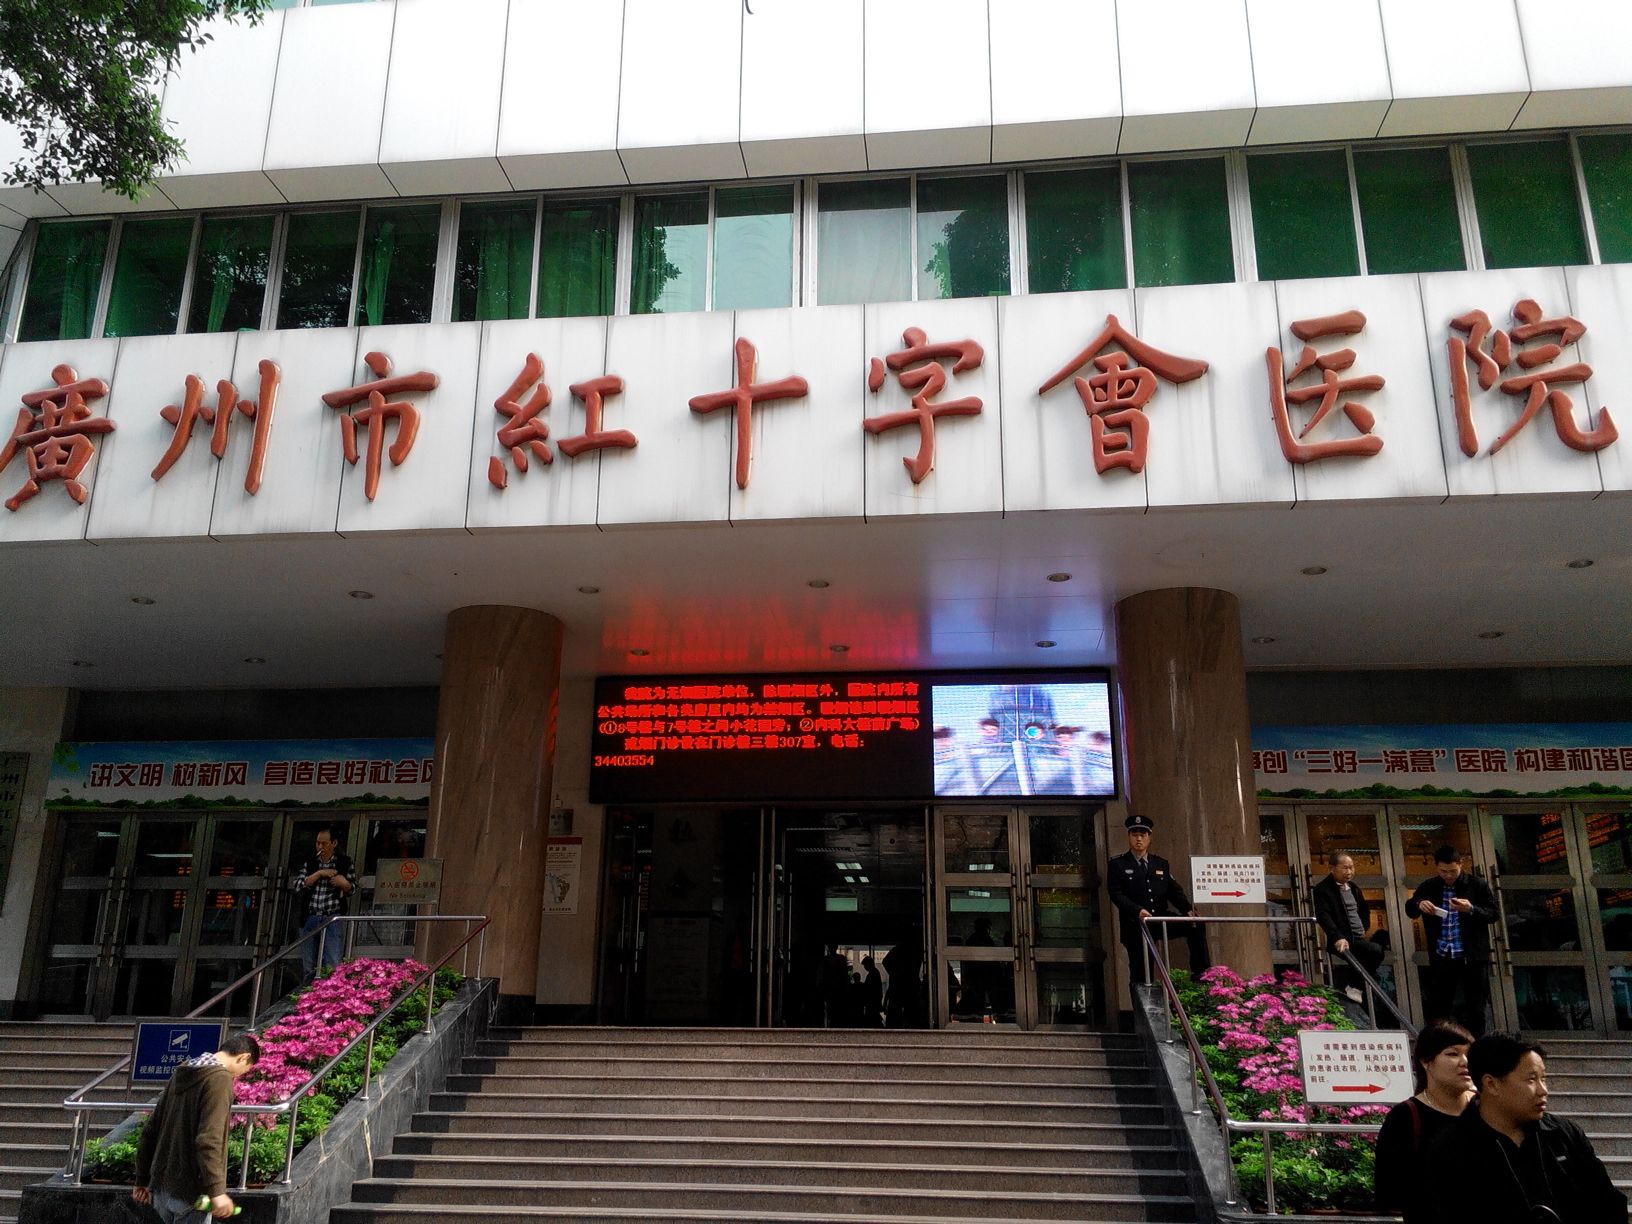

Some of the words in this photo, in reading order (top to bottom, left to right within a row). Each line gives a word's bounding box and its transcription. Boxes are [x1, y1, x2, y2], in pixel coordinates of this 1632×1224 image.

[594, 755, 654, 766] 34403554
[90, 762, 163, 788] 讲文明
[171, 761, 248, 787] 树新风
